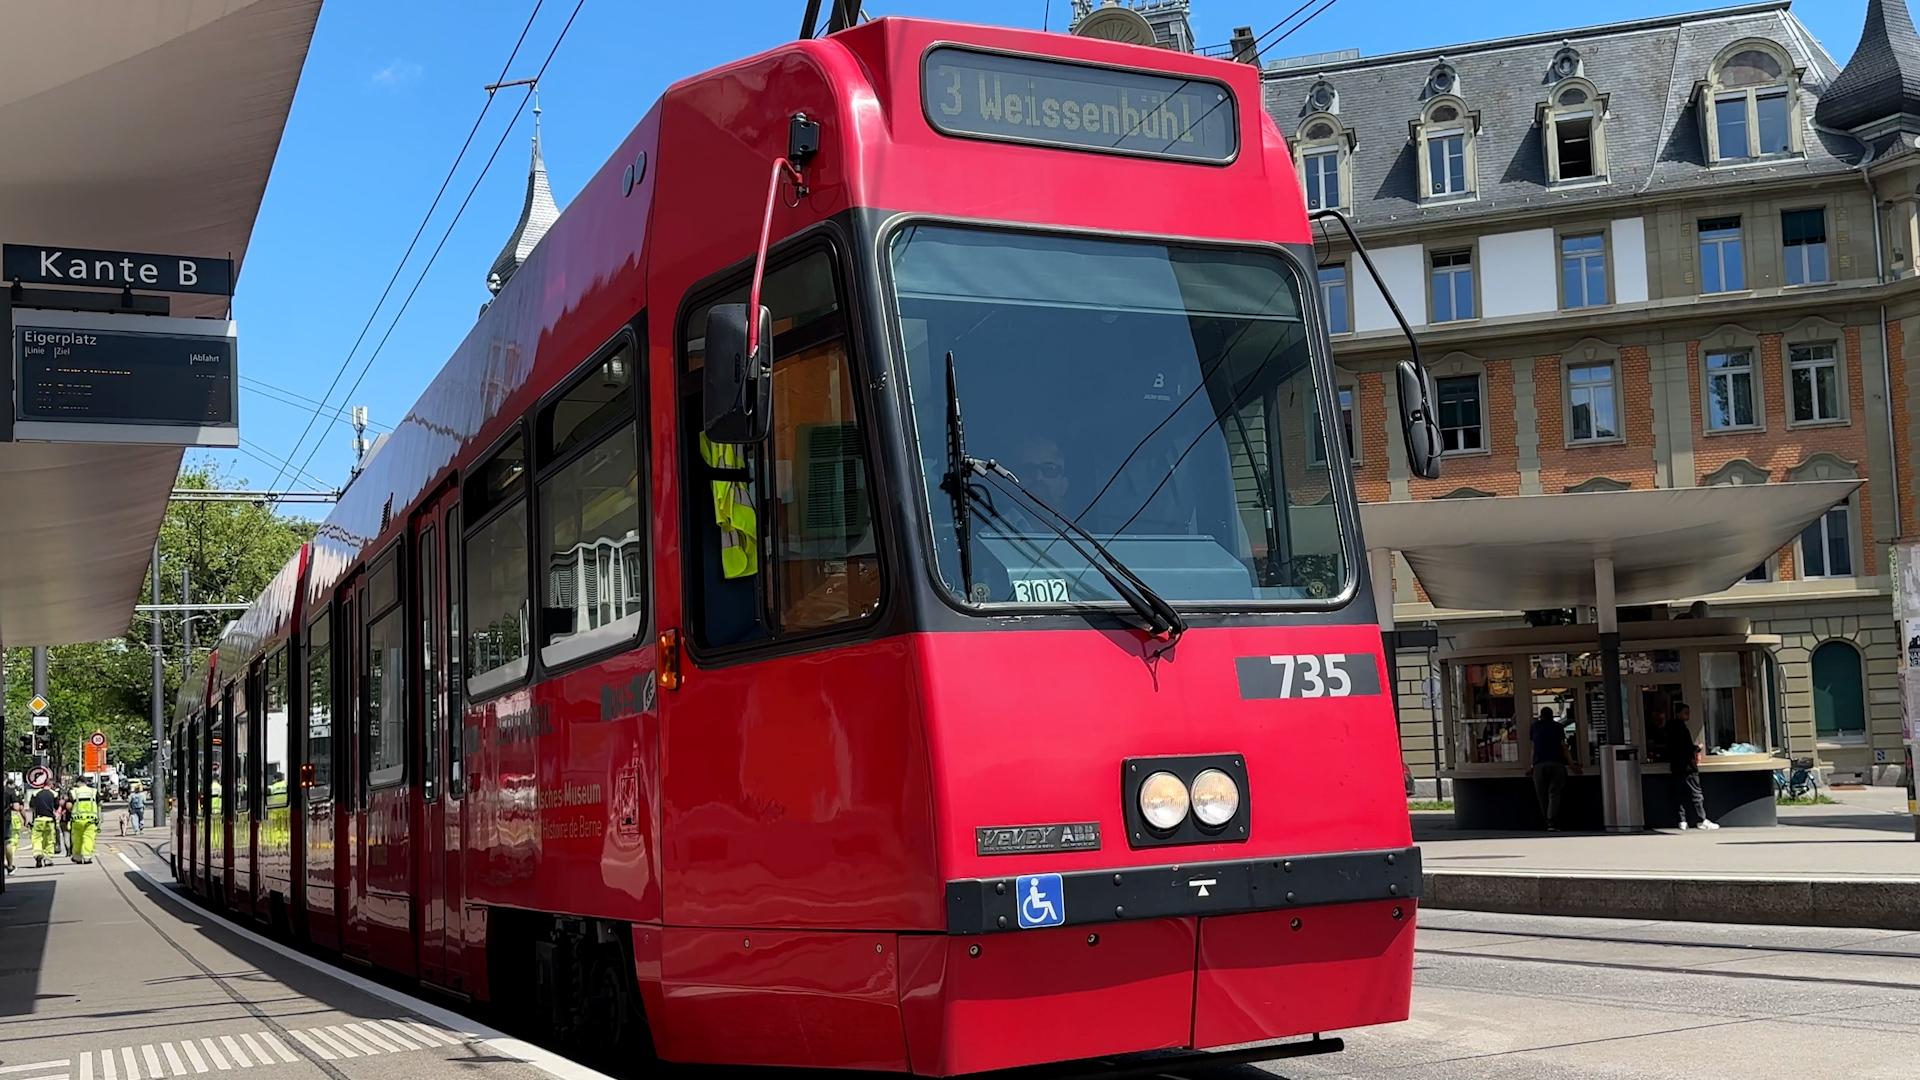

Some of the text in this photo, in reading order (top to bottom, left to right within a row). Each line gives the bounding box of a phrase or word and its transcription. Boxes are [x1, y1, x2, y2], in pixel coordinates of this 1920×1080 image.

[938, 64, 1195, 144] 3 Weissenbühl
[39, 250, 198, 286] Kante B
[24, 330, 97, 346] Eigerplatz
[27, 346, 220, 363] Linie Ziel Abfahrt
[1016, 581, 1067, 602] 302
[1269, 653, 1352, 699] 735
[564, 781, 601, 806] Museum
[579, 815, 602, 838] Berne
